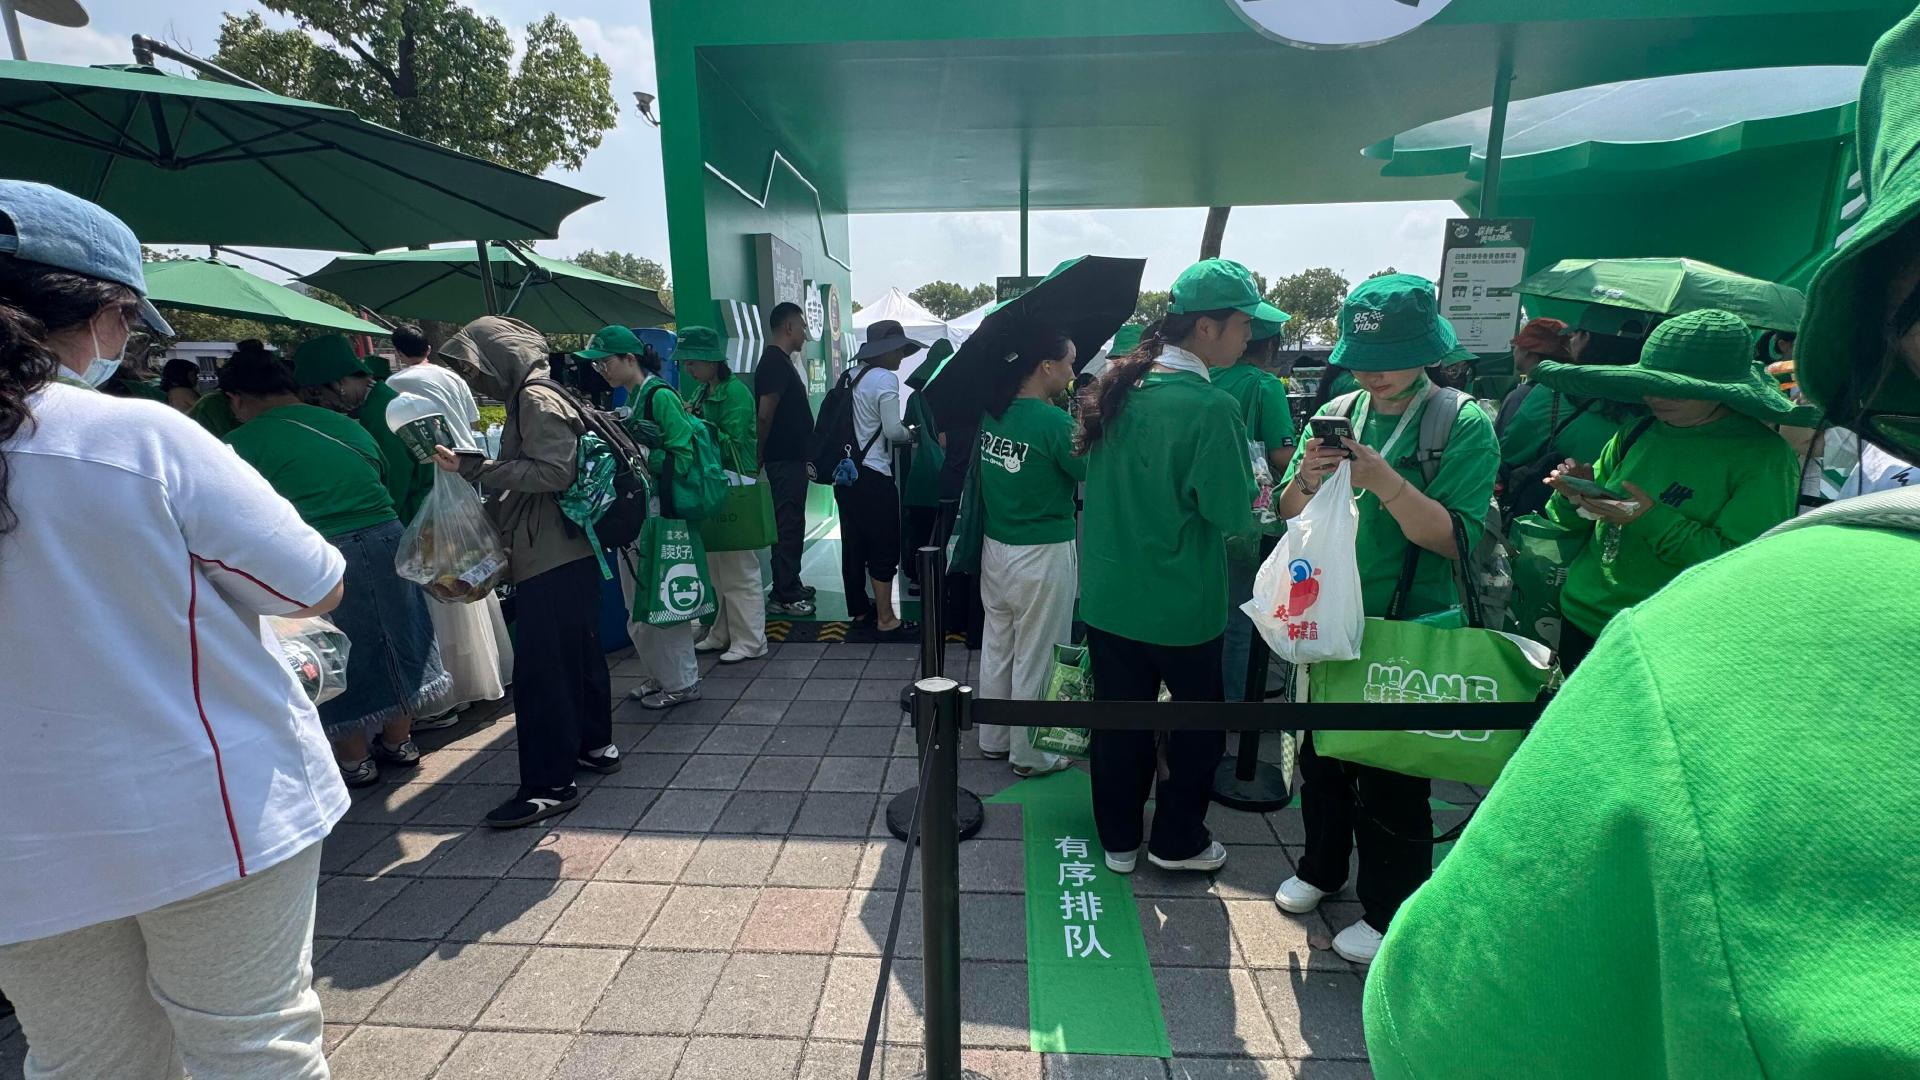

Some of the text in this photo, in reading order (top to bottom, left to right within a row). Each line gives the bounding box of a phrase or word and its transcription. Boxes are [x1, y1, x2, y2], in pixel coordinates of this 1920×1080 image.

[1353, 312, 1370, 323] 85
[1353, 321, 1379, 334] yibo
[1054, 835, 1112, 959] 有序排队
